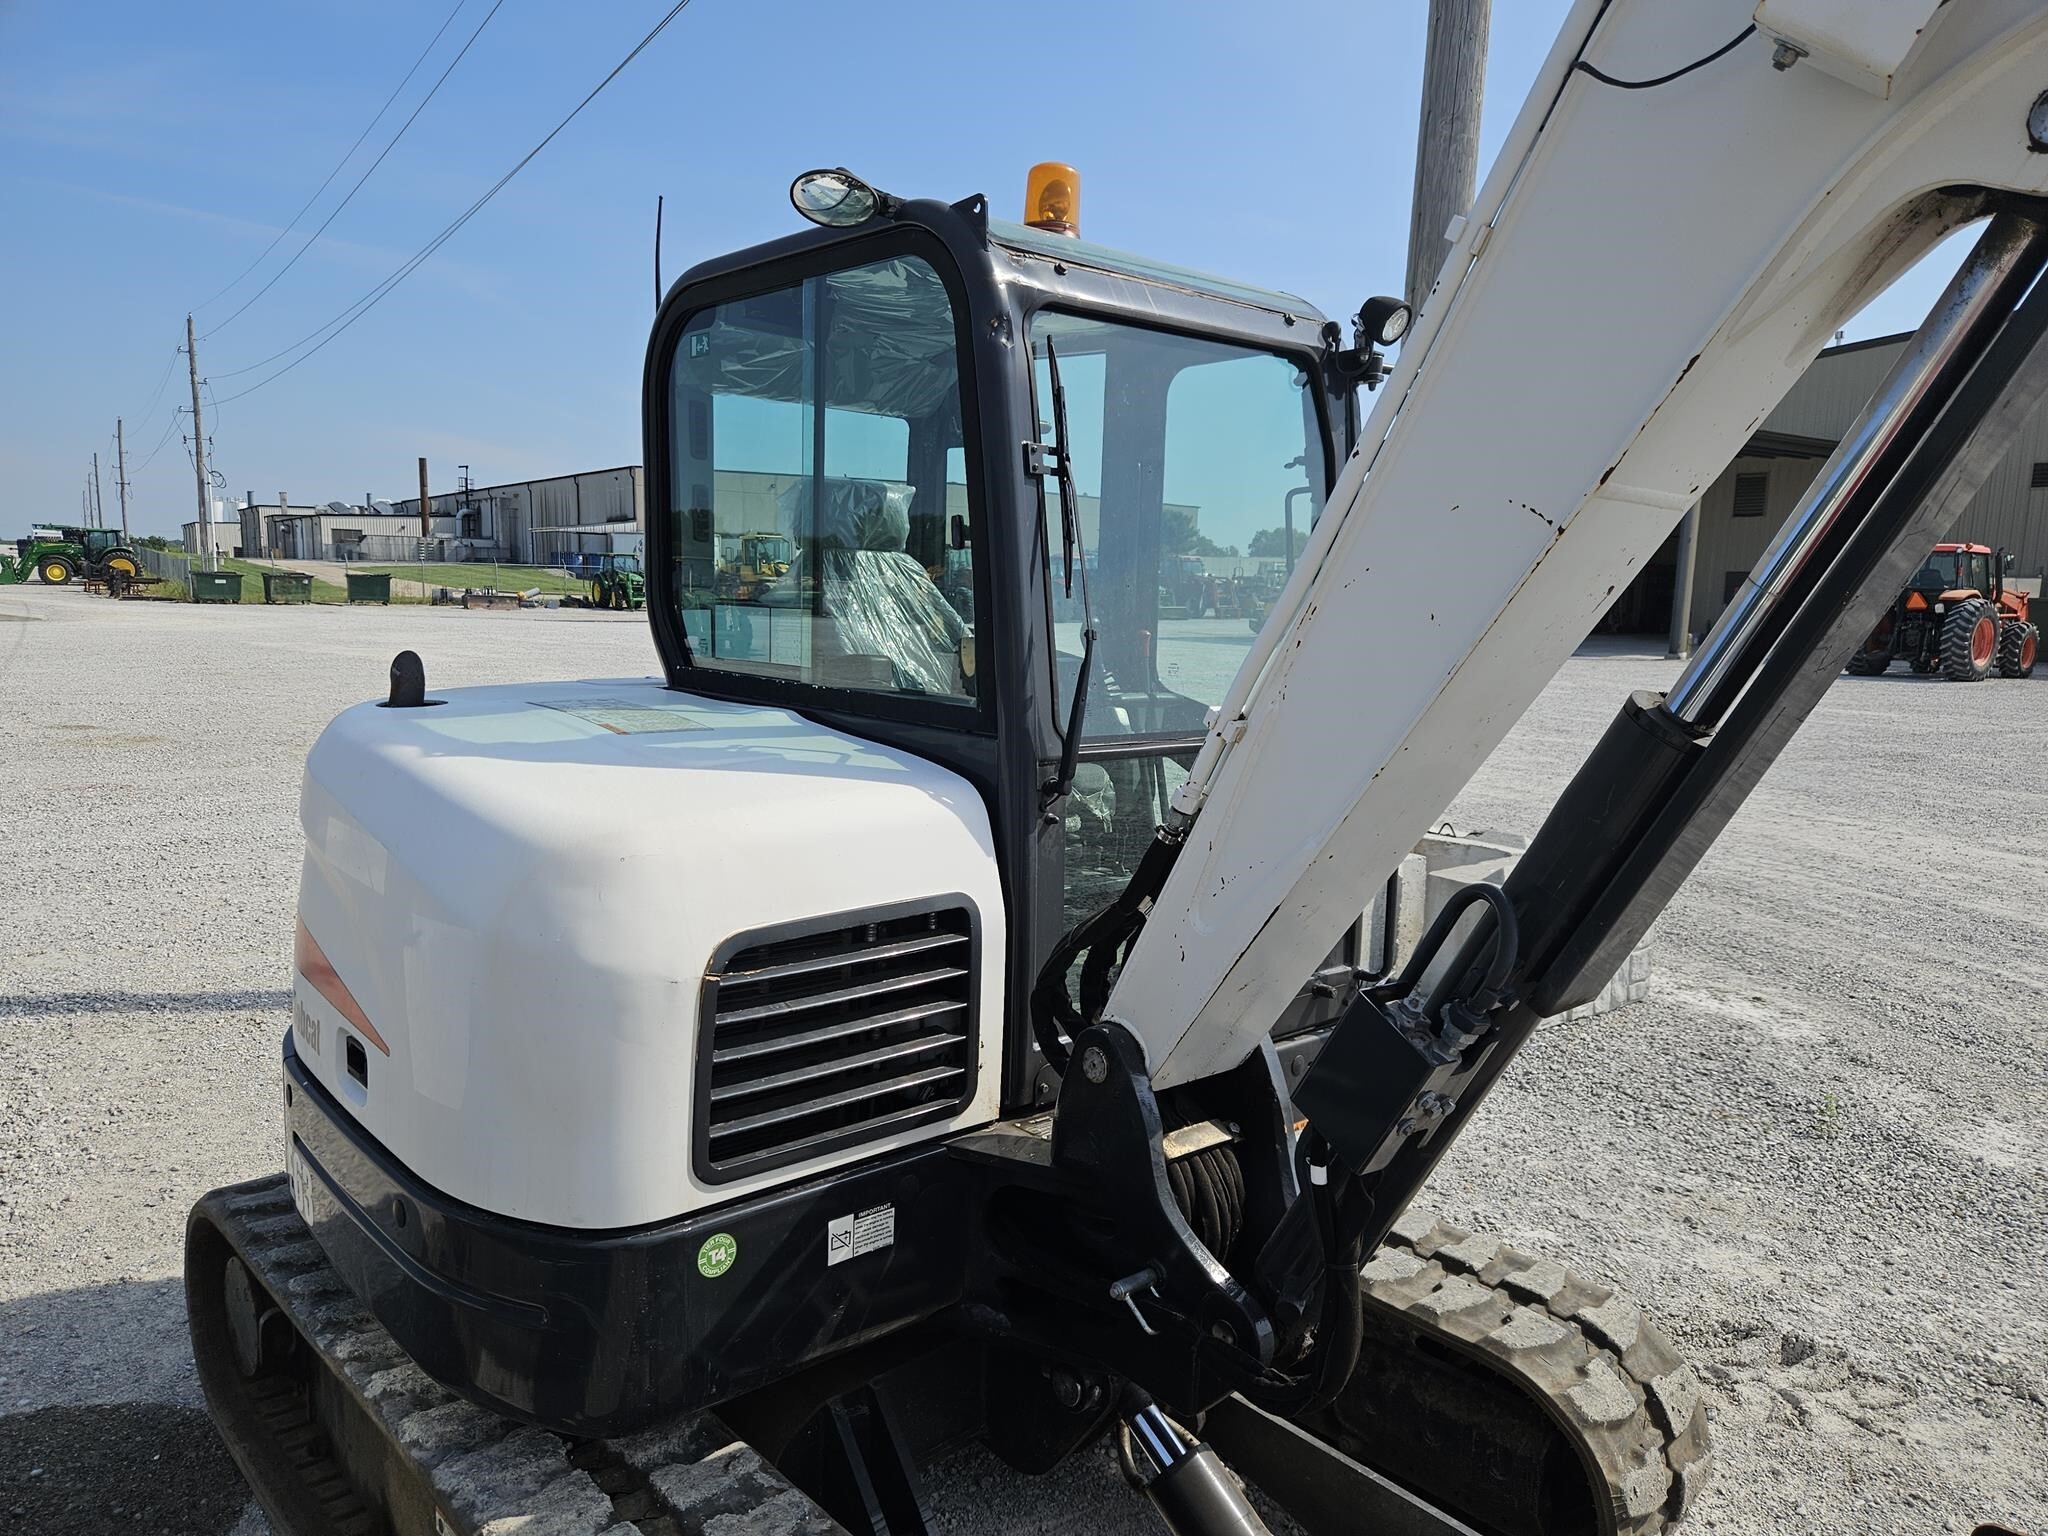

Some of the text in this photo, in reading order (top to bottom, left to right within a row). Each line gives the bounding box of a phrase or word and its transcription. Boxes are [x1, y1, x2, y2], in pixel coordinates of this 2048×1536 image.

[858, 1202, 892, 1219] IMPORTANT
[702, 1239, 715, 1253] TIER
[708, 1246, 727, 1265] T4
[702, 1257, 732, 1275] COMPLIANT
